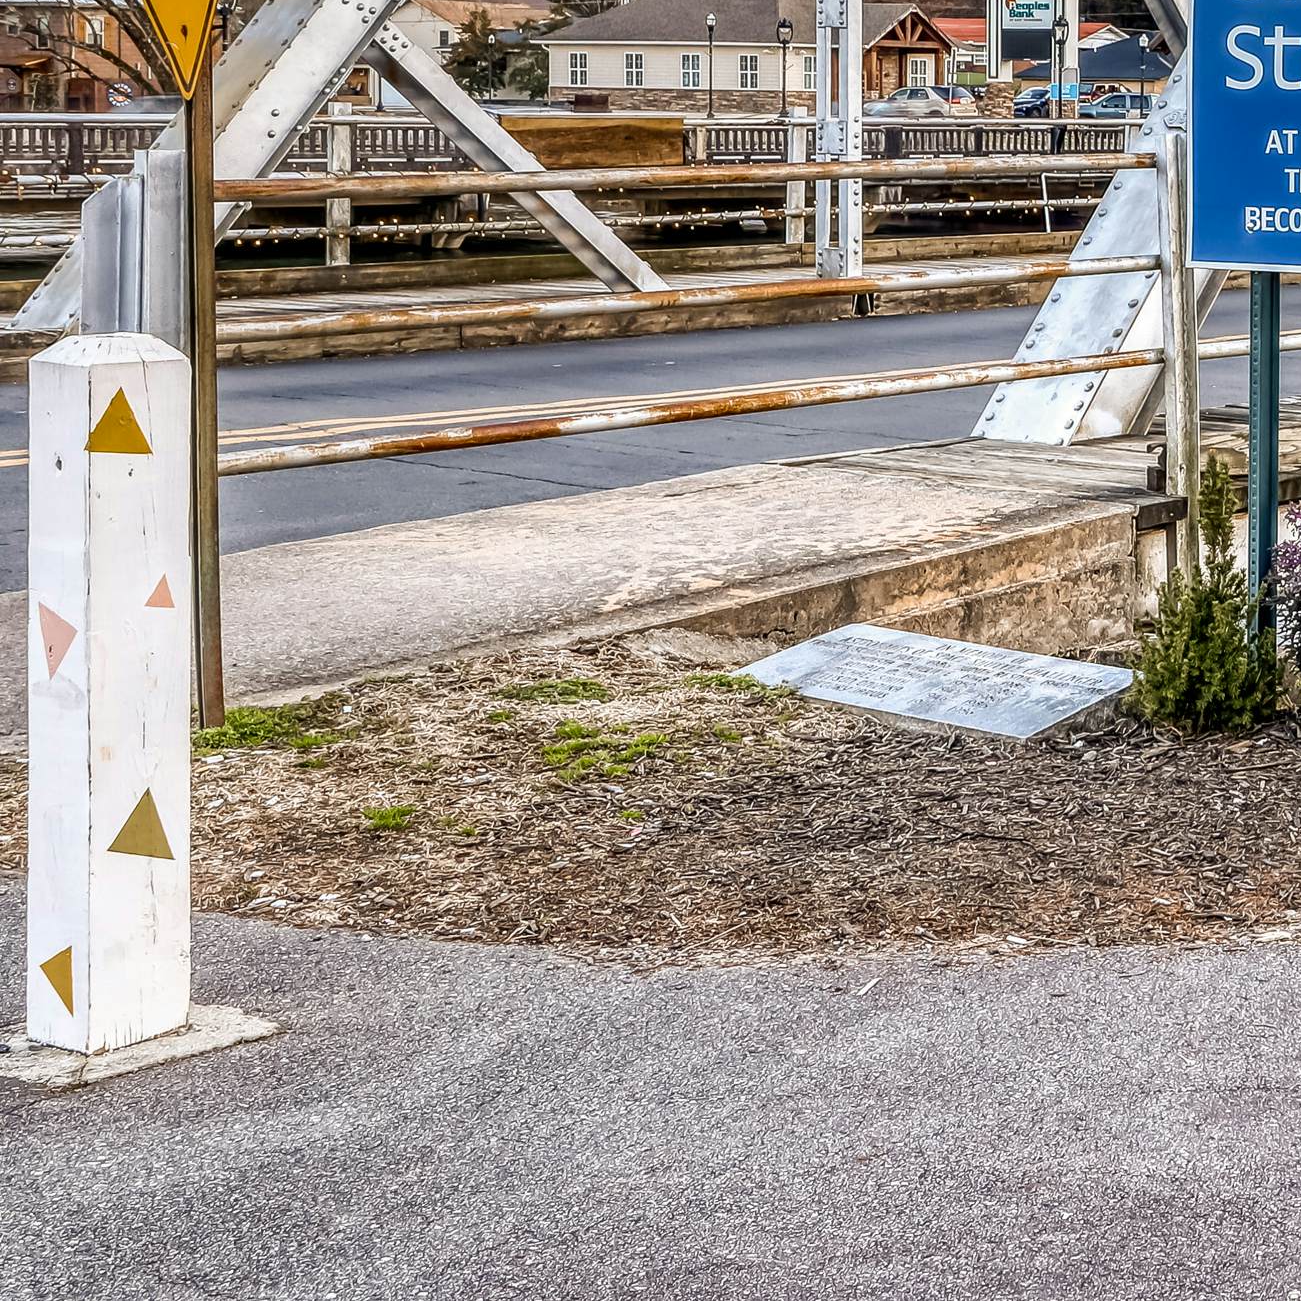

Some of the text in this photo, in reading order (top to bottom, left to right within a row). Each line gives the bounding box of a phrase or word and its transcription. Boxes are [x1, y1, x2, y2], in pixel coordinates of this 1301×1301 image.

[1009, 1, 1050, 10] Peoples
[1009, 9, 1034, 17] Bank
[1265, 129, 1299, 155] AT
[1020, 667, 1104, 686] CHALLENGER
